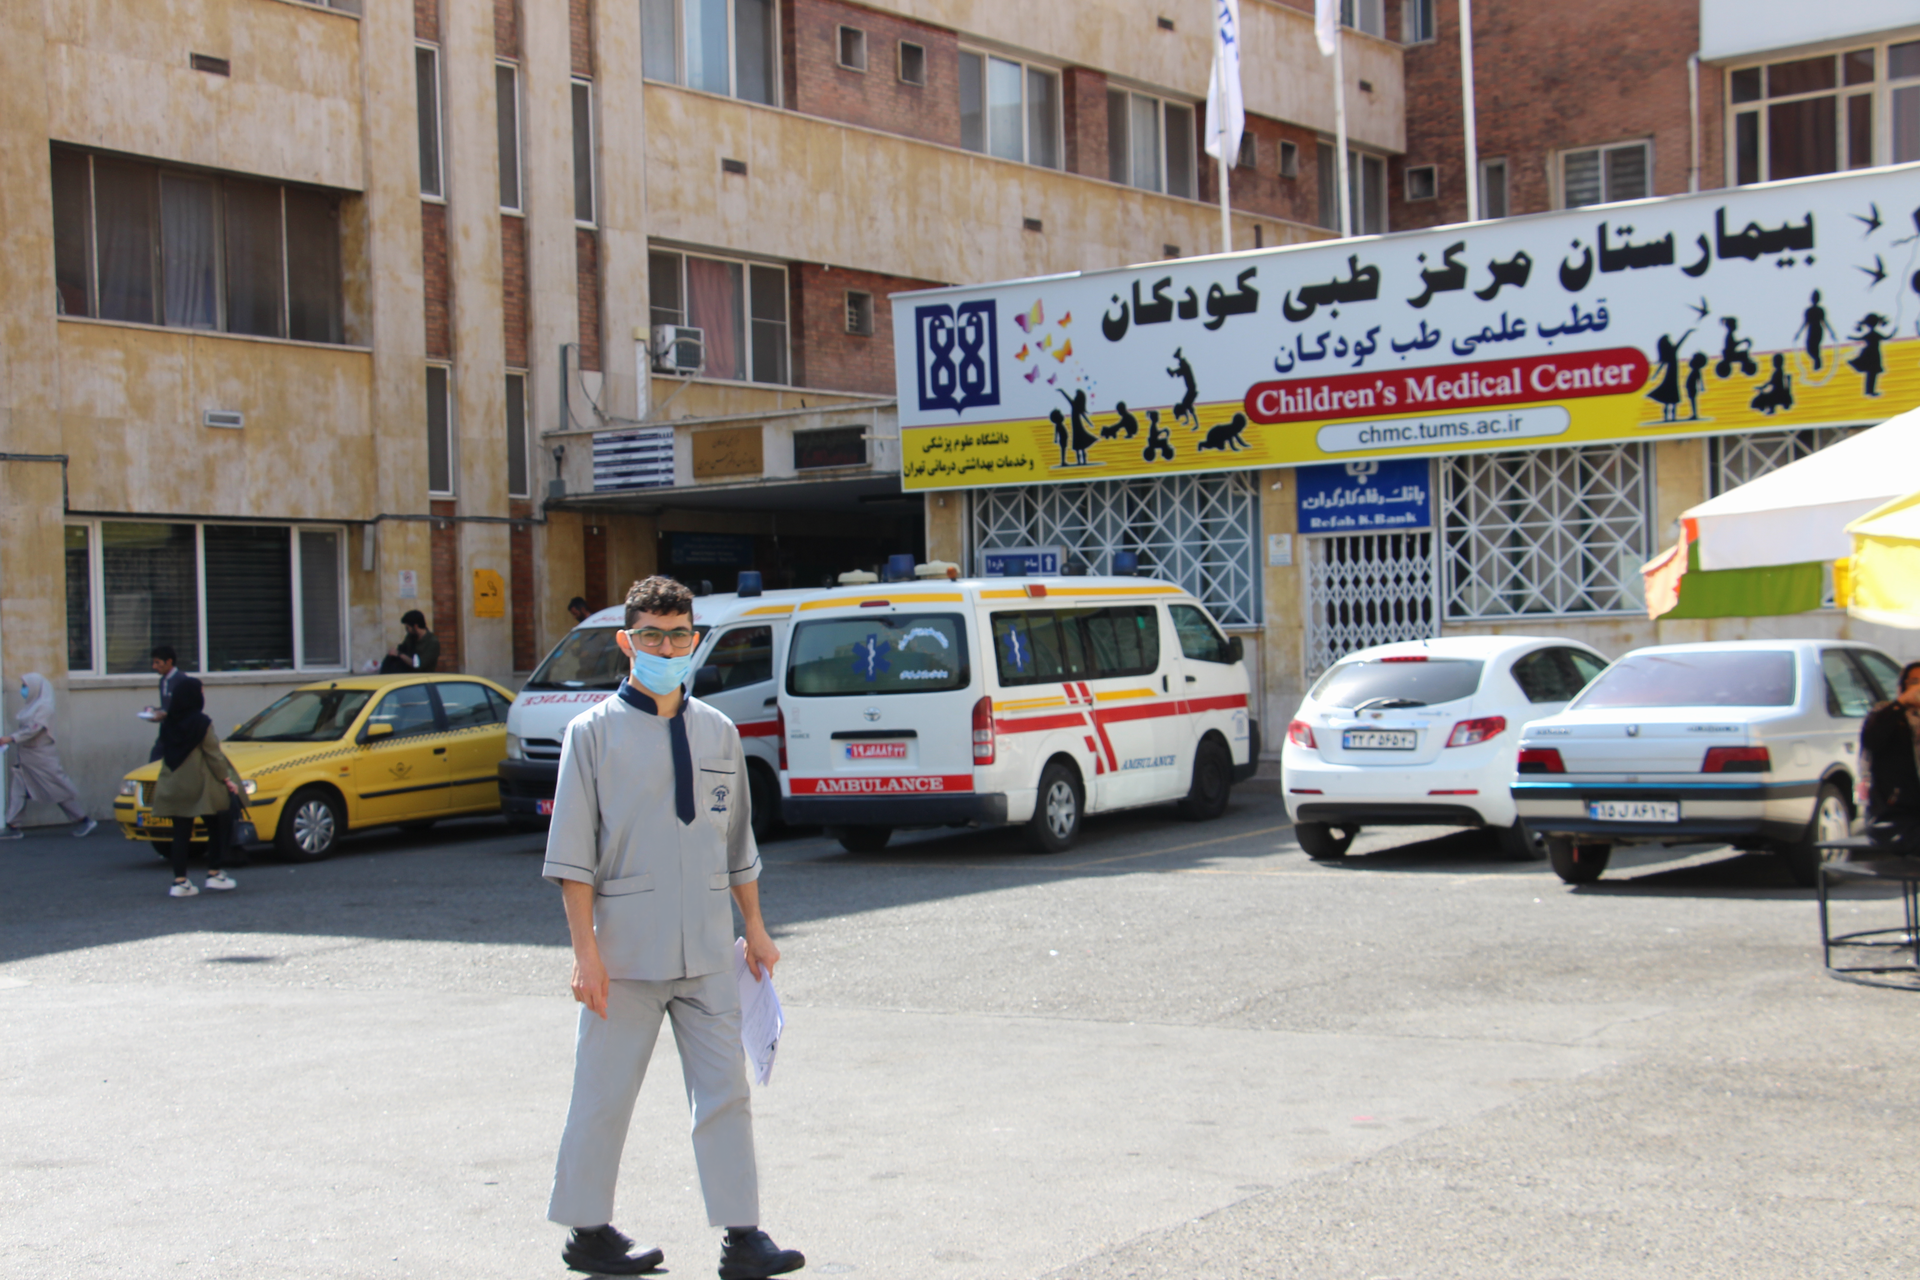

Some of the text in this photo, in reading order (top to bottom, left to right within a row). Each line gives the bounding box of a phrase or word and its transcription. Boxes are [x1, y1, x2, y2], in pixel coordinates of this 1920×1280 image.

[1101, 205, 1815, 342] بیمارستان مرکز طبی کودکان
[1274, 298, 1610, 373] قطب علمی طب کودکان
[1256, 362, 1636, 416] Children's Medical Center
[1359, 413, 1523, 444] chmc.tums.ac.ir
[922, 432, 1009, 453] دانشگاه علوم پزشکی
[903, 460, 926, 477] تهران
[927, 459, 956, 476] درمانی
[957, 457, 994, 474] بهداشتی
[996, 454, 1028, 468] خدمات
[1302, 485, 1426, 510] بانک رفاه کارگران
[1310, 515, 1356, 529] Refah
[1121, 755, 1176, 771] AMBULANCE
[815, 777, 944, 793] AMBULANCE
